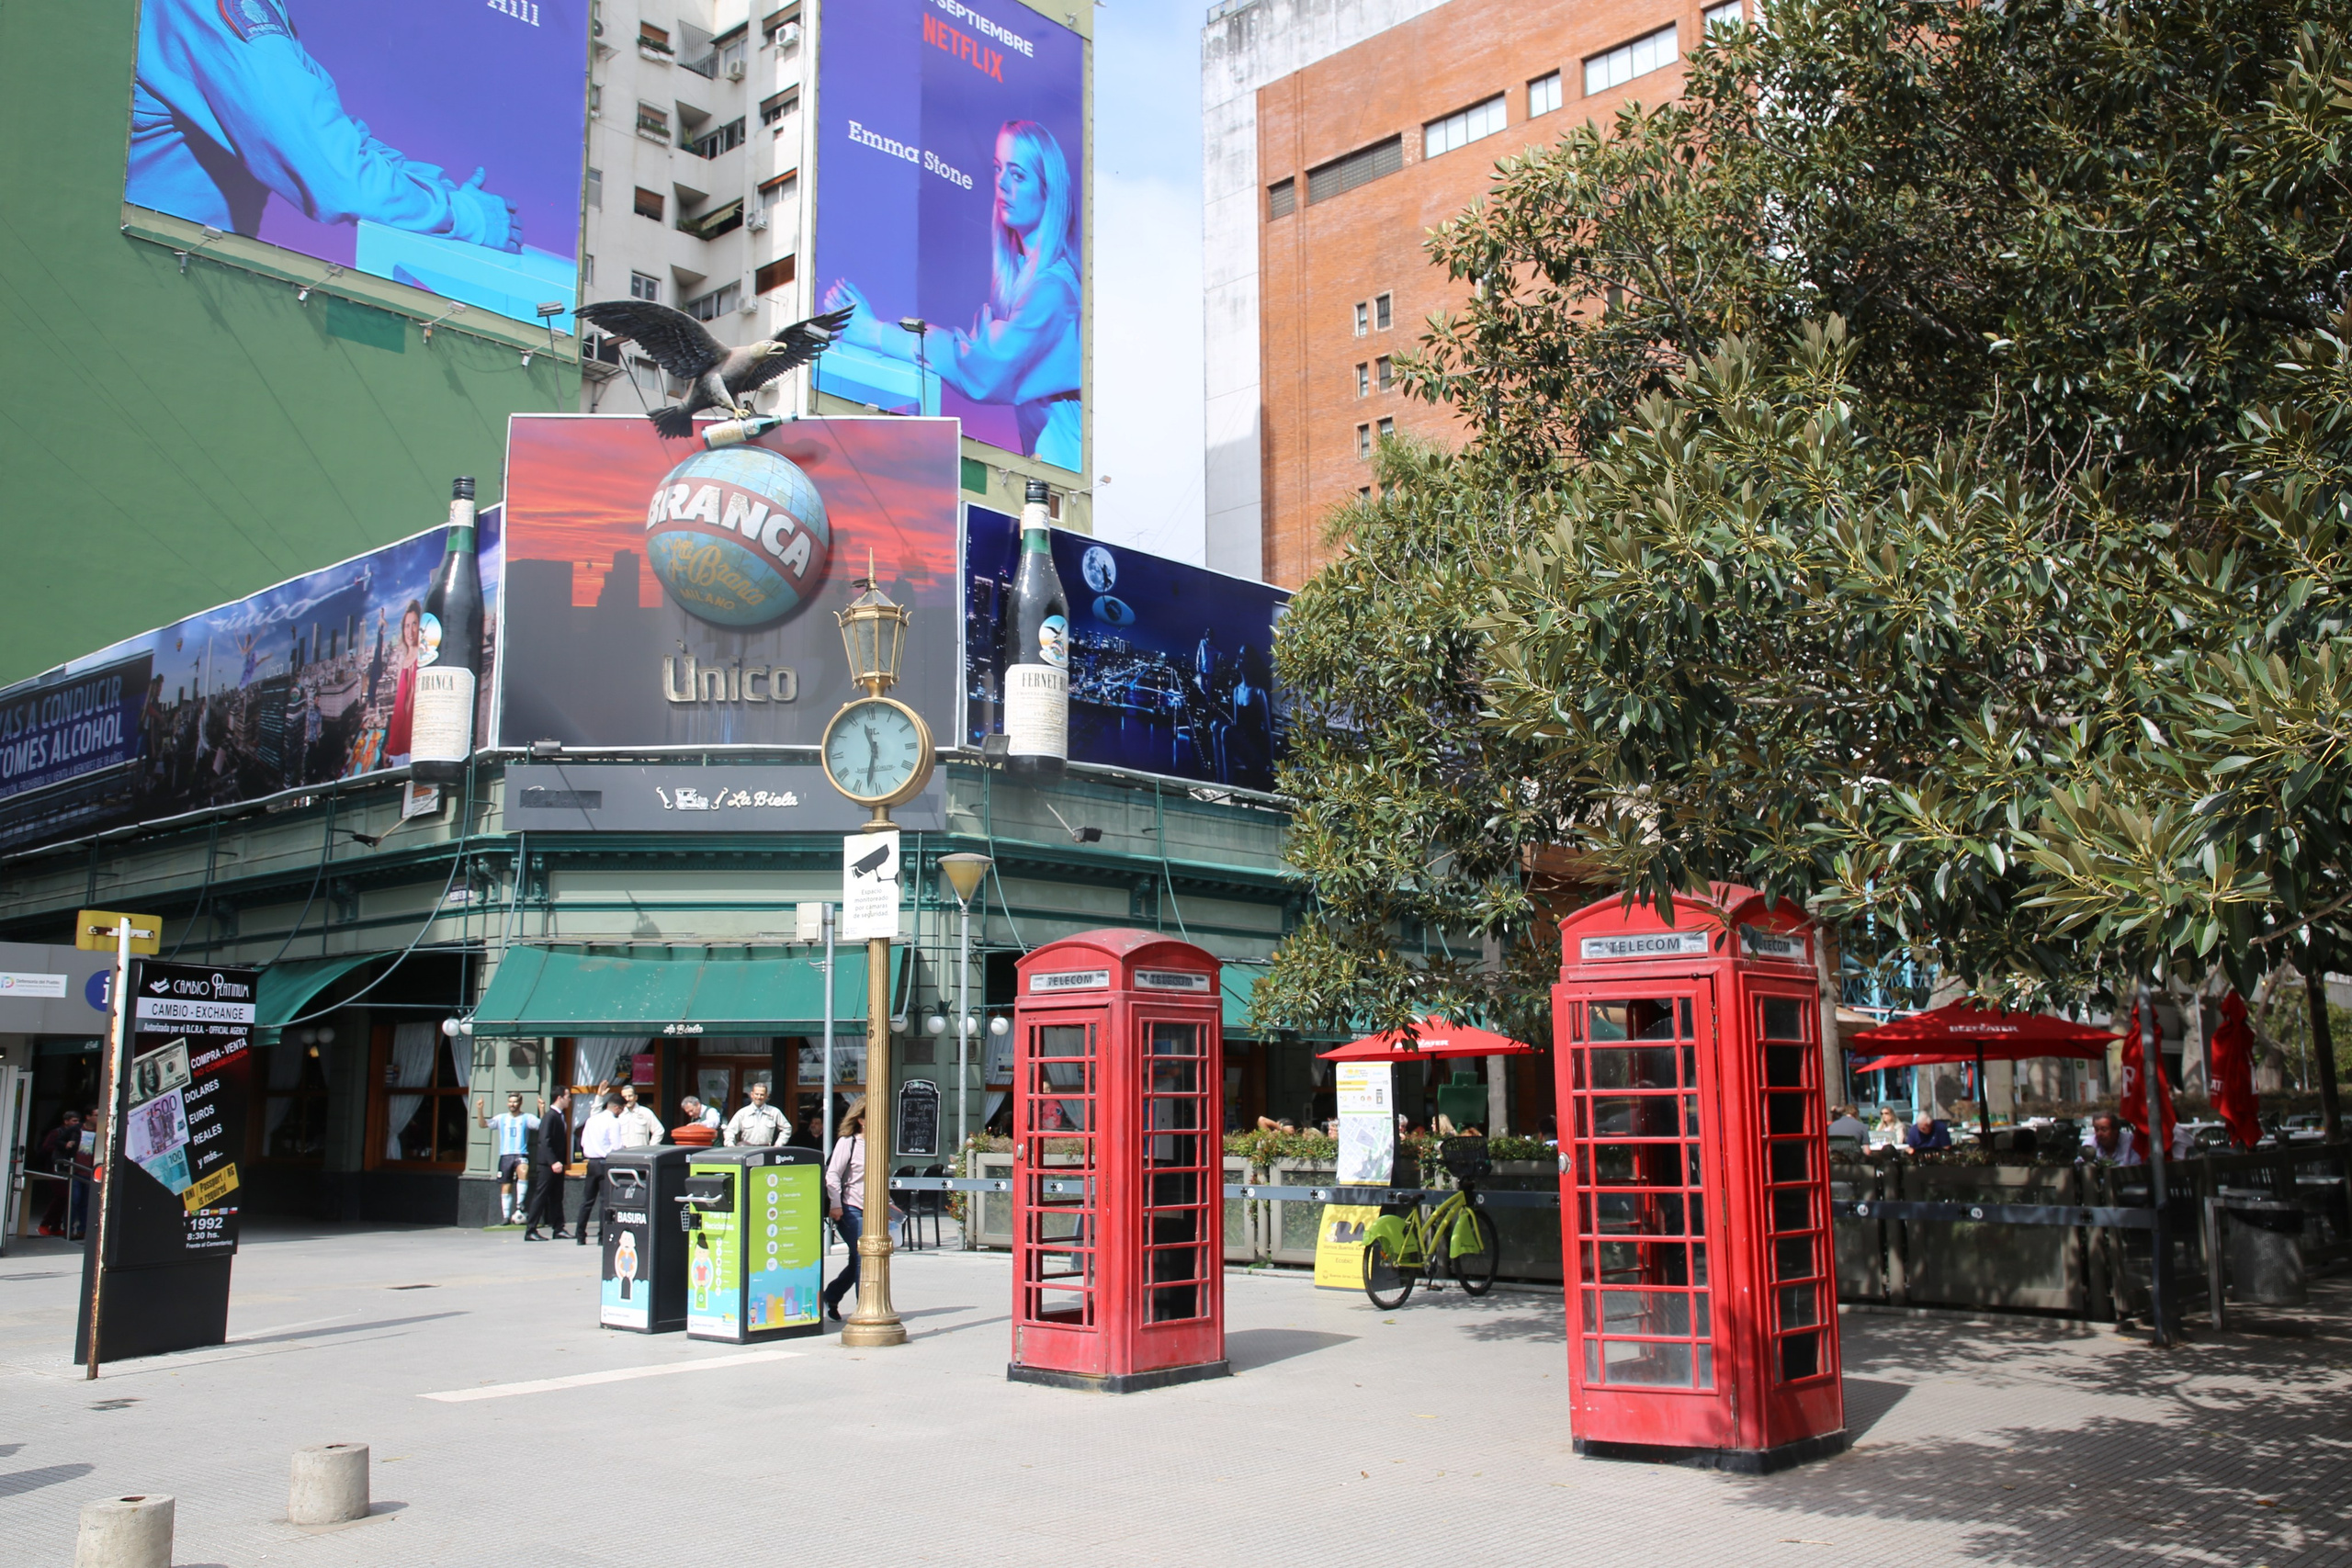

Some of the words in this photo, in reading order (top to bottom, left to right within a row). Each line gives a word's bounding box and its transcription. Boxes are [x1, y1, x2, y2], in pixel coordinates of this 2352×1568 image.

[936, 0, 1034, 58] SEPTIEMBRE
[923, 12, 1003, 84] NETFLIX
[848, 119, 920, 164] Emma
[923, 150, 974, 190] Stone
[646, 483, 812, 579] BRANCA
[688, 545, 766, 606] Branca
[680, 588, 735, 610] MILANO
[421, 674, 455, 692] BRANCA
[1022, 671, 1057, 691] FERNET
[26, 700, 37, 735] A
[40, 675, 122, 729] CONDUCIR
[50, 711, 124, 765] ALCOHOL
[728, 790, 752, 808] La
[753, 790, 799, 807] Biela
[854, 896, 889, 904] monitoreado
[861, 888, 883, 897] Espacio
[865, 902, 888, 911] cámaras
[1609, 937, 1680, 953] TELECOM
[1756, 939, 1792, 953] ELECOM
[173, 979, 209, 996] CAMBIO
[1047, 974, 1094, 987] TELECOM
[1148, 973, 1193, 987] TELECOM
[152, 1003, 189, 1018] CAMBIO
[196, 1006, 244, 1021] EXCHANGE
[142, 1021, 170, 1033] Autorizada
[170, 1024, 180, 1034] por
[209, 1025, 229, 1035] OFFICIAL
[230, 1026, 249, 1035] AGENCY
[662, 1023, 676, 1036] La
[675, 1023, 704, 1035] Biela
[1949, 1024, 2019, 1033] BEEFEATER
[190, 1048, 222, 1069] COMPRA
[223, 1037, 248, 1055] VENTA
[193, 1066, 205, 1078] NO
[205, 1048, 249, 1071] COMMISSION
[184, 1078, 220, 1104] DOLARES
[188, 1104, 216, 1125] EUROS
[192, 1122, 223, 1146] REALES
[509, 1127, 517, 1137] 10
[197, 1157, 203, 1170] y
[198, 1172, 223, 1193] Passport
[198, 1196, 204, 1207] is
[204, 1183, 227, 1203] required
[190, 1216, 224, 1232] 1992
[617, 1211, 647, 1224] BASURA
